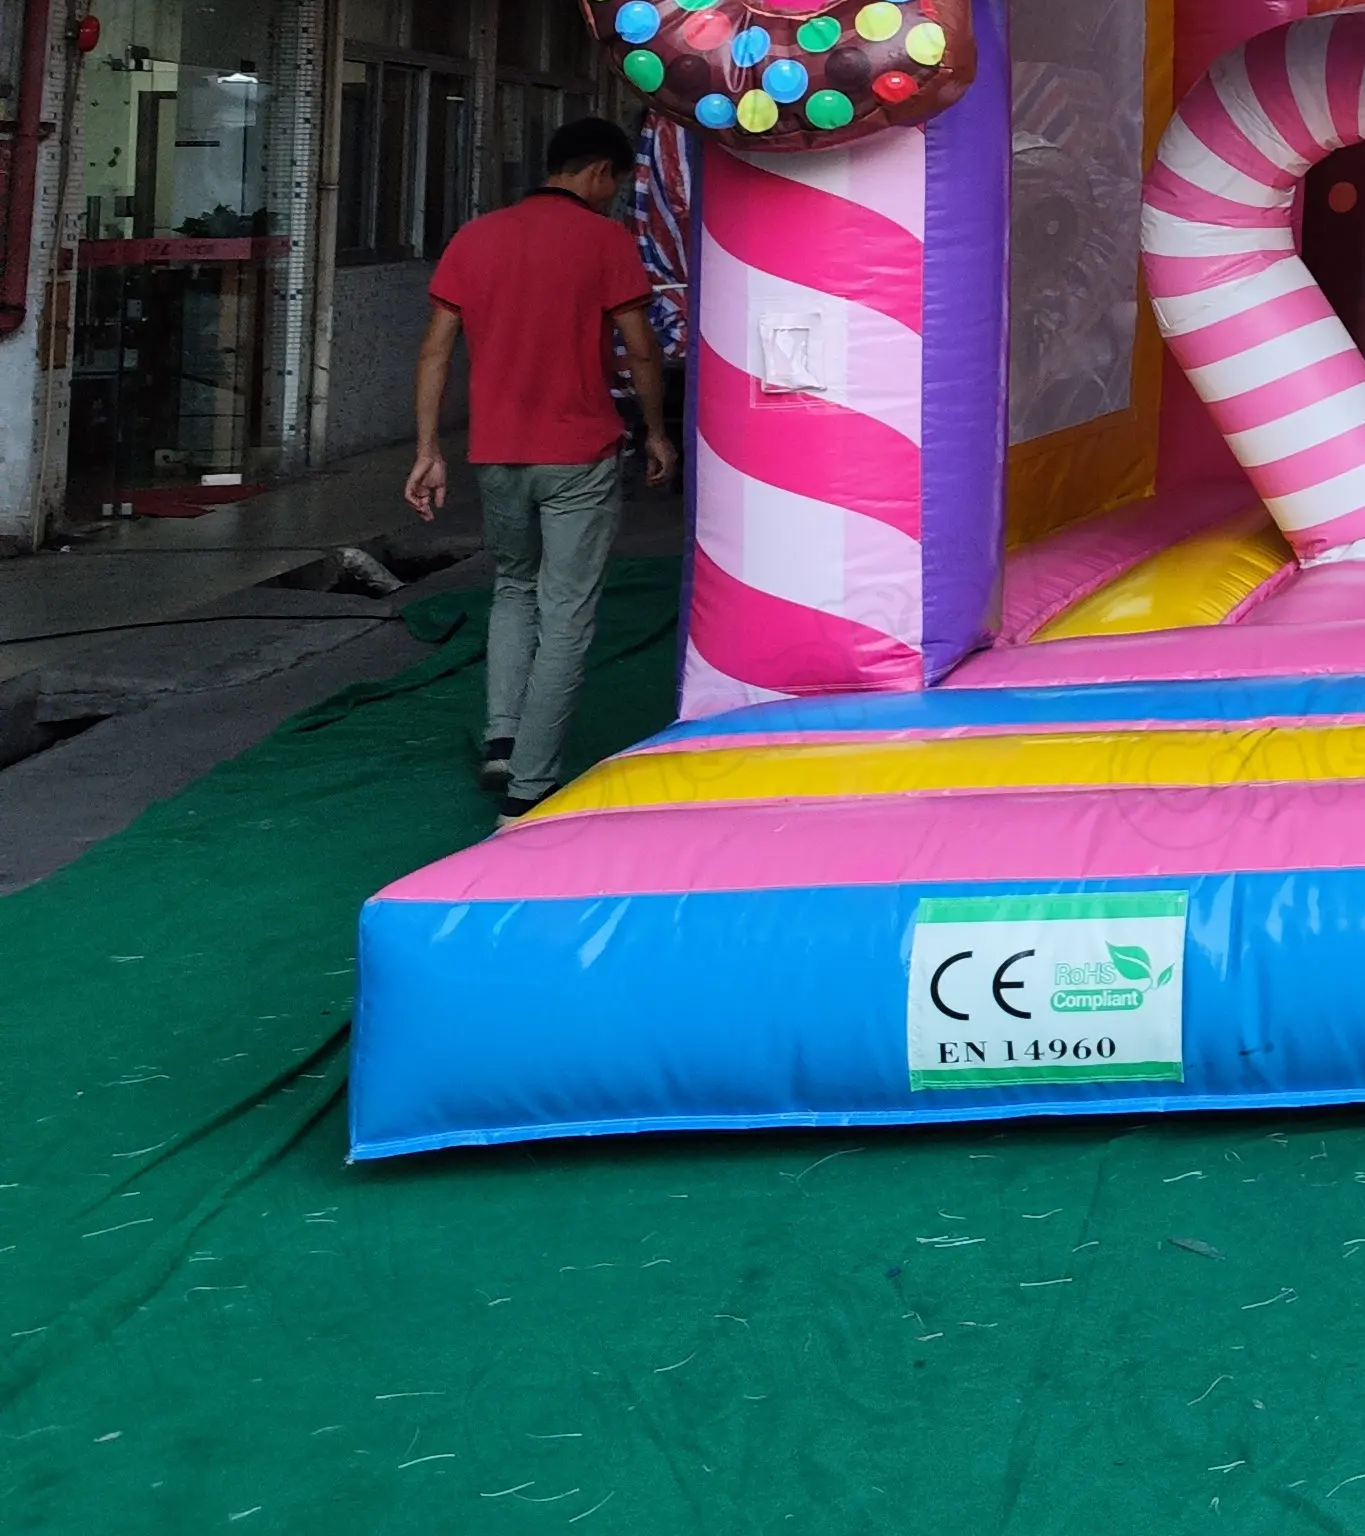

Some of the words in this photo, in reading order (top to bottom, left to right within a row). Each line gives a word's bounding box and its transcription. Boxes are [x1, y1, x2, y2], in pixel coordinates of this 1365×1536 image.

[929, 949, 1036, 1021] CE
[1054, 962, 1117, 986] RoHS
[1053, 990, 1139, 1011] Compliant
[937, 1040, 988, 1065] EN
[1003, 1036, 1117, 1062] 14960
